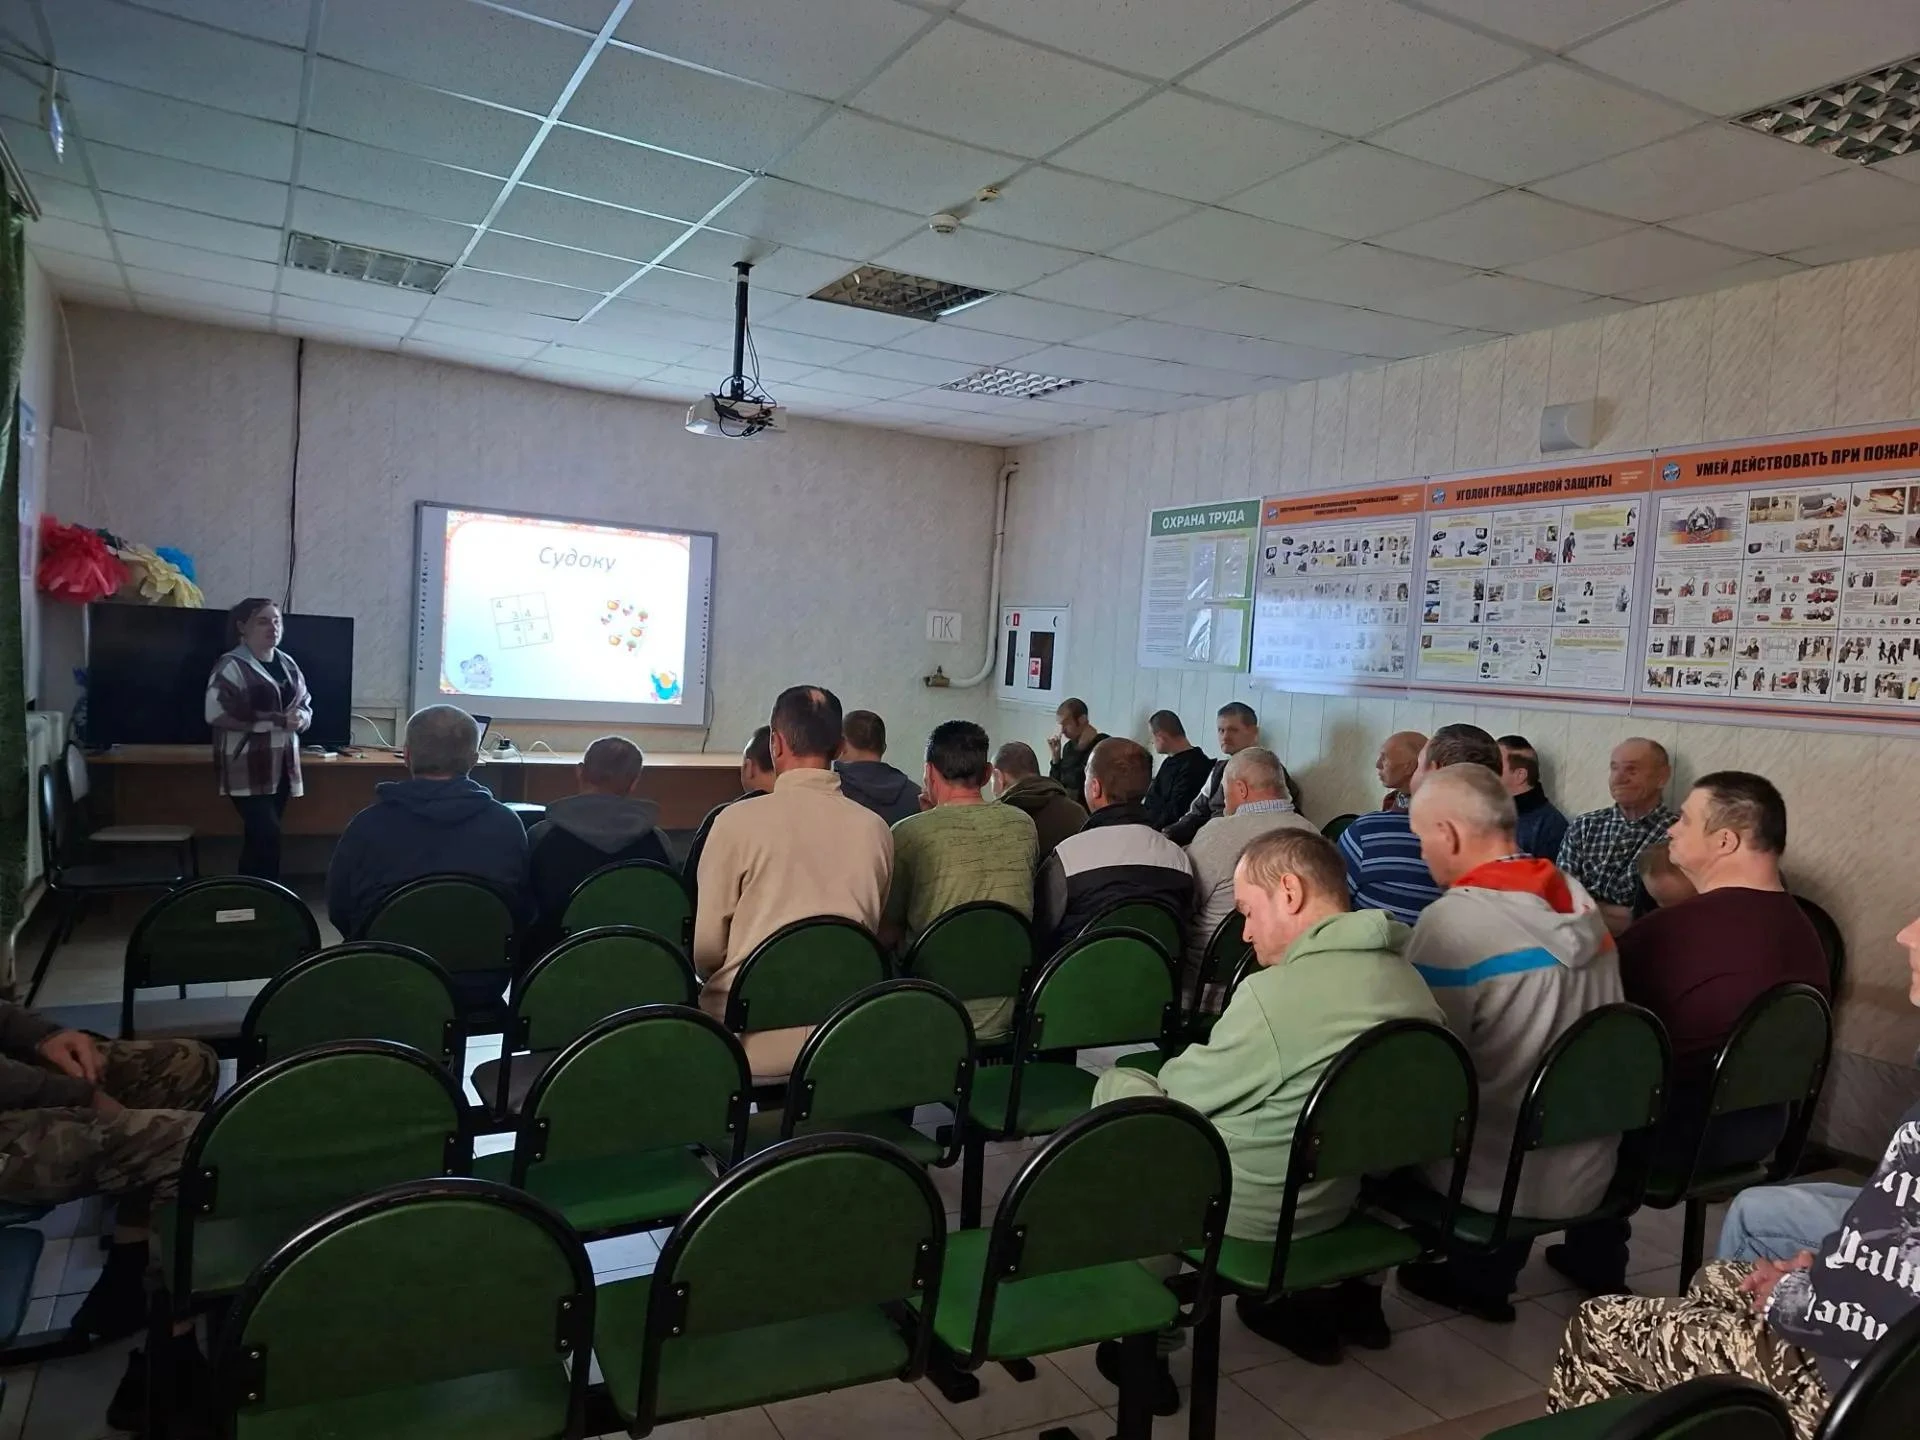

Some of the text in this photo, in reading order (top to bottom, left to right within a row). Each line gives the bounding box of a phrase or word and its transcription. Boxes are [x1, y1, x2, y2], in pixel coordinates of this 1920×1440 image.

[1696, 458, 1729, 477] УМЕЙ
[1731, 451, 1828, 476] ДЕЙСТВОВАТЬ
[1831, 447, 1860, 465] ПРИ
[1456, 484, 1490, 501] УГОЛОК
[1491, 479, 1562, 498] ГРАЖДАНСКОЙ
[1563, 473, 1612, 491] ЗАЩИТЫ
[1162, 508, 1245, 530] ОХРАНА ТРУДА
[539, 546, 616, 573] Судоку
[932, 615, 954, 638] ПК
